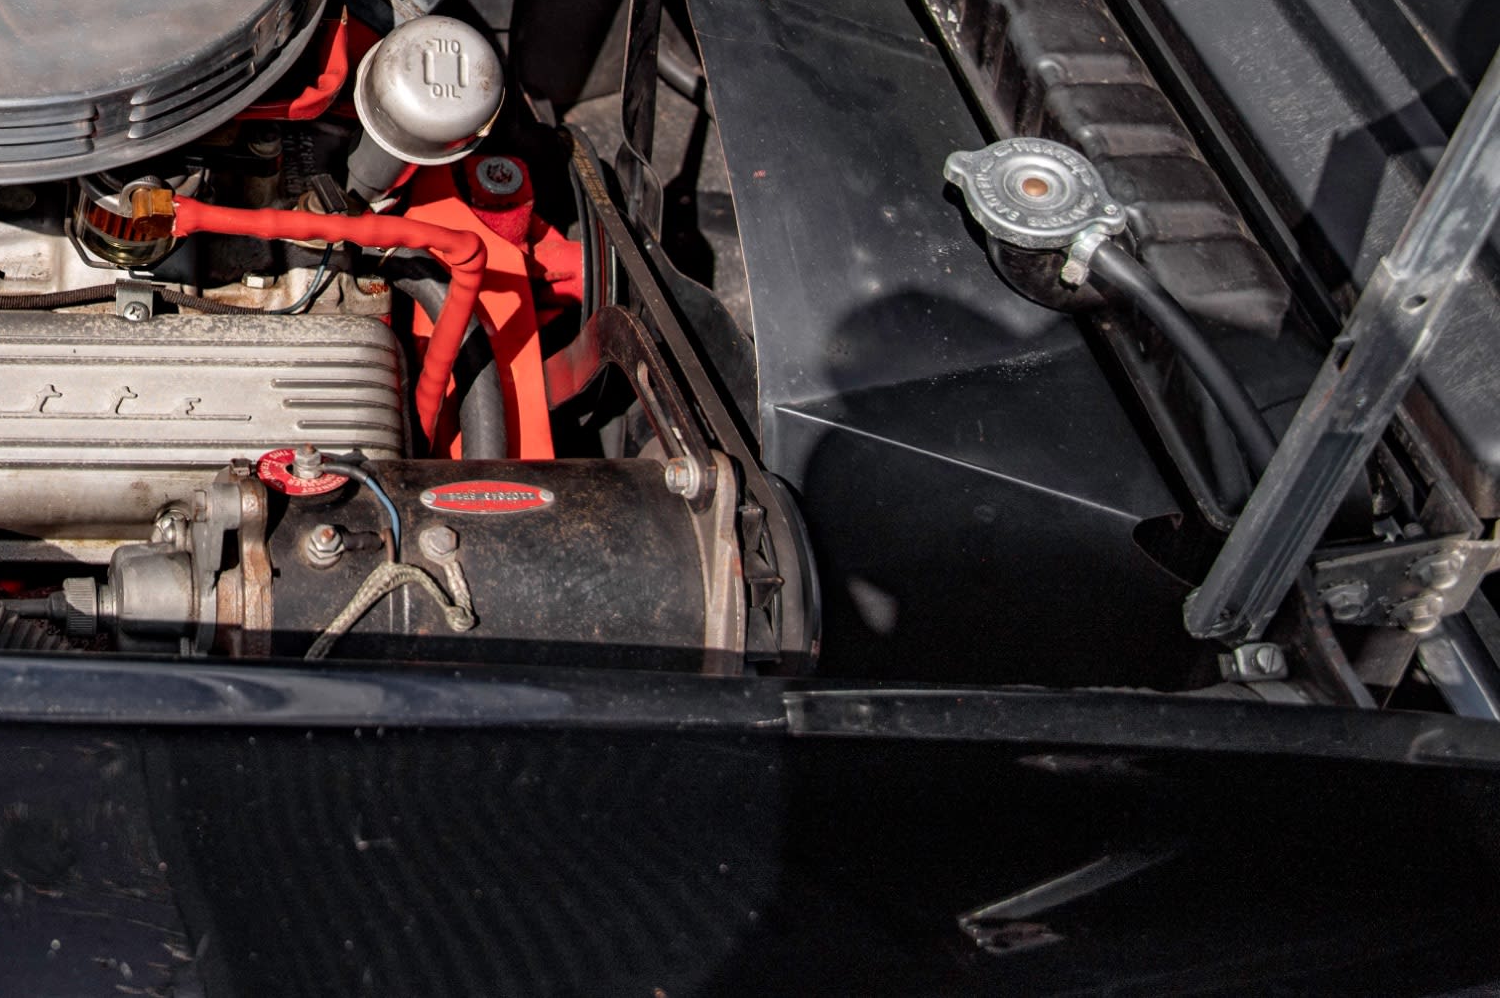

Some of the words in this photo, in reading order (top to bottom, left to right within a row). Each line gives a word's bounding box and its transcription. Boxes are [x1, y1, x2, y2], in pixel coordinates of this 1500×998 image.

[431, 37, 461, 54] OIL
[431, 82, 461, 99] OIL
[268, 449, 290, 459] THIS
